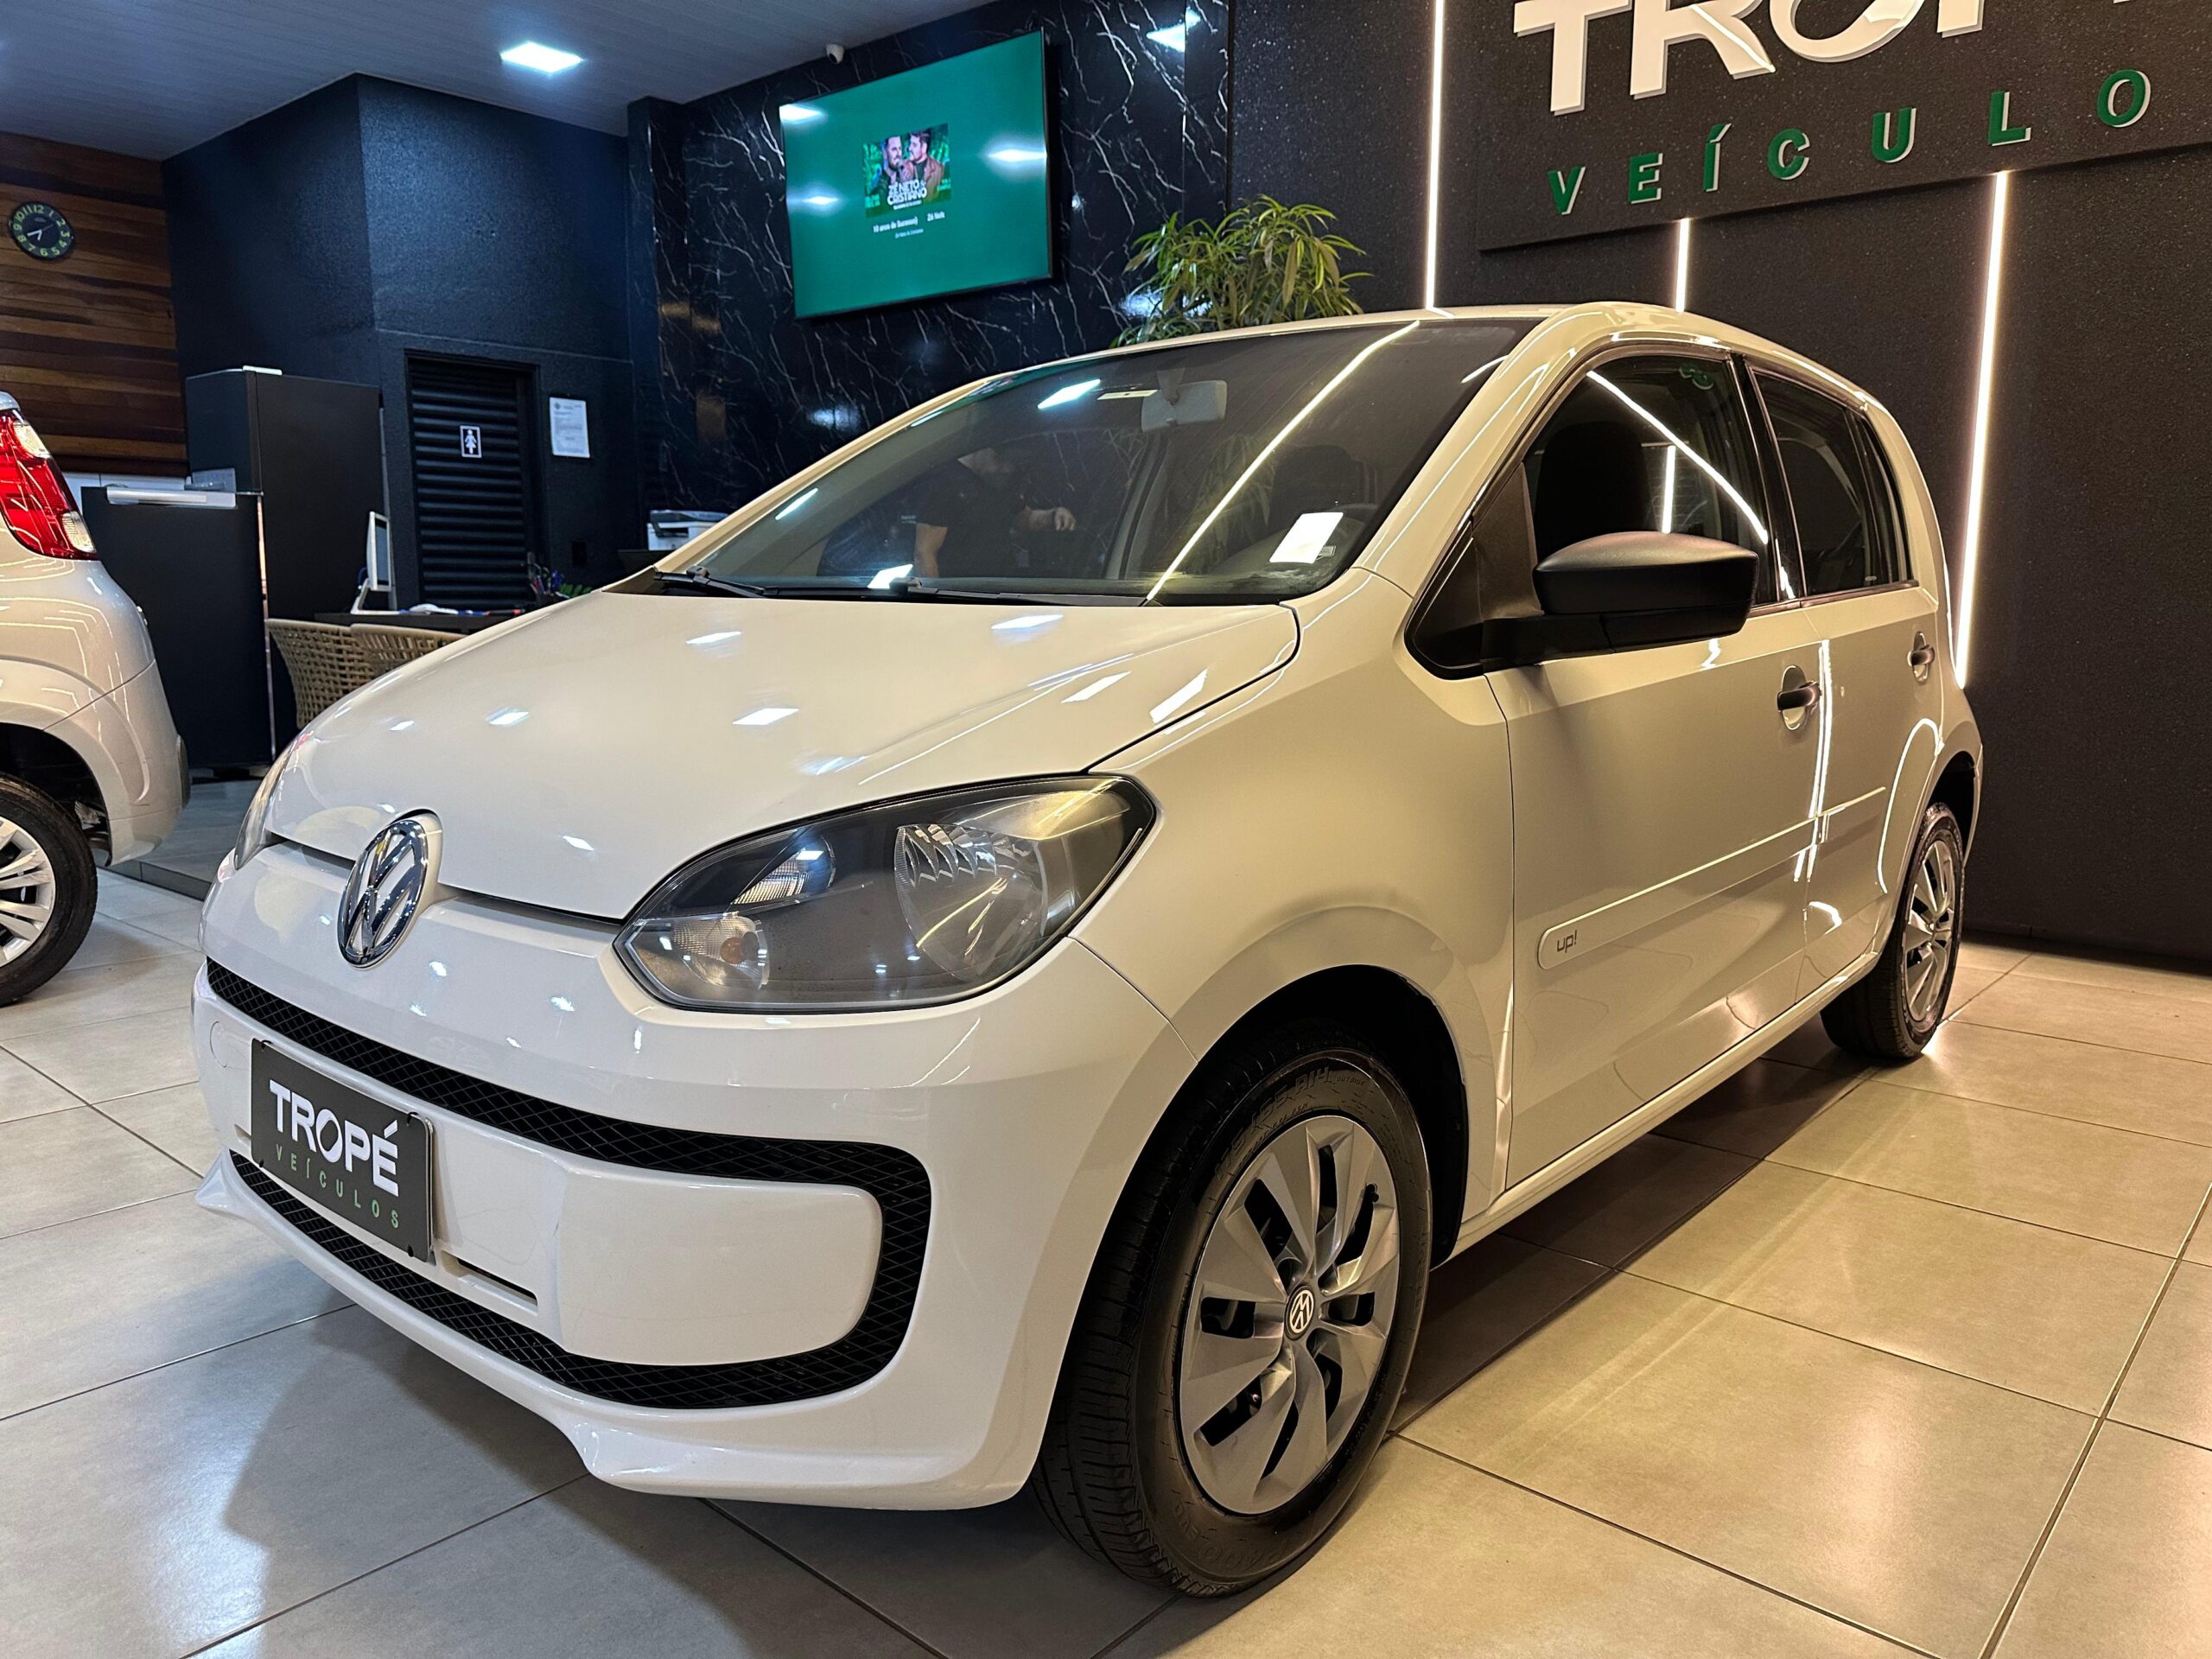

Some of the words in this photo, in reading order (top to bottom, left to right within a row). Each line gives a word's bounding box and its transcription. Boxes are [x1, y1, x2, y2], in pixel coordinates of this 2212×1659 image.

[1514, 0, 2132, 117] TRO
[887, 187, 927, 205] CRISTIANO
[22, 205, 33, 215] 11
[34, 204, 44, 214] 12
[48, 209, 54, 218] 1
[15, 211, 25, 222] 10
[56, 218, 66, 226] 2
[29, 243, 35, 252] 7
[40, 248, 48, 257] 6
[51, 247, 60, 256] 5
[1556, 929, 1577, 953] up!
[269, 1078, 399, 1198] TROPÉ
[276, 1143, 400, 1229] VEÍCULOS
